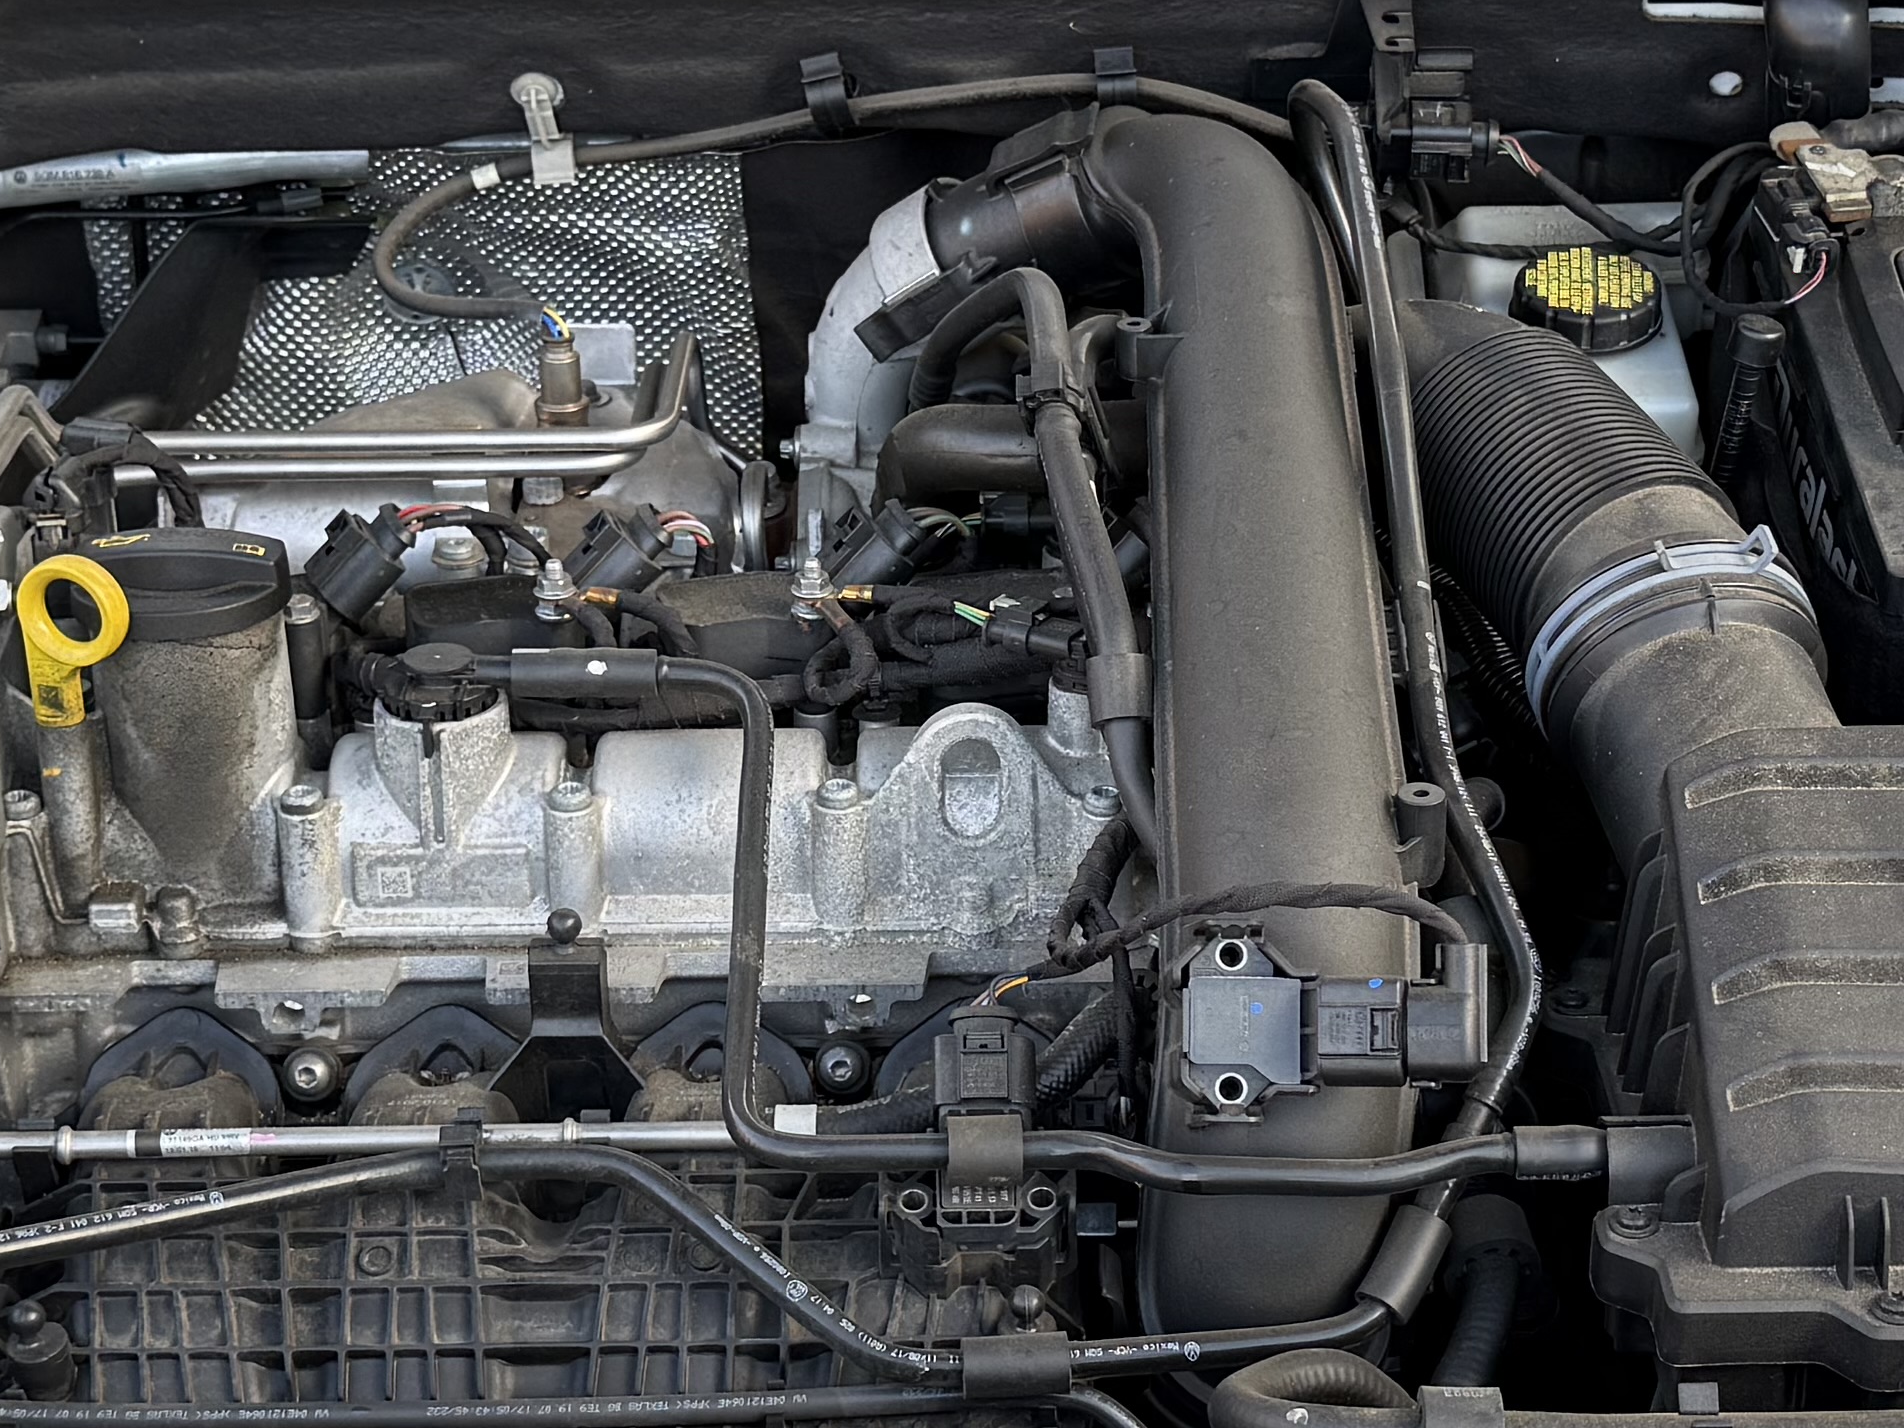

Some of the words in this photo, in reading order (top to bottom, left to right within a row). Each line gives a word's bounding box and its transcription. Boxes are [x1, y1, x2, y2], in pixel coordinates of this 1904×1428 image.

[94, 1212, 114, 1223] 612
[718, 1396, 786, 1408] 04E121064E
[791, 1394, 808, 1404] VW
[579, 1403, 600, 1413] TE9
